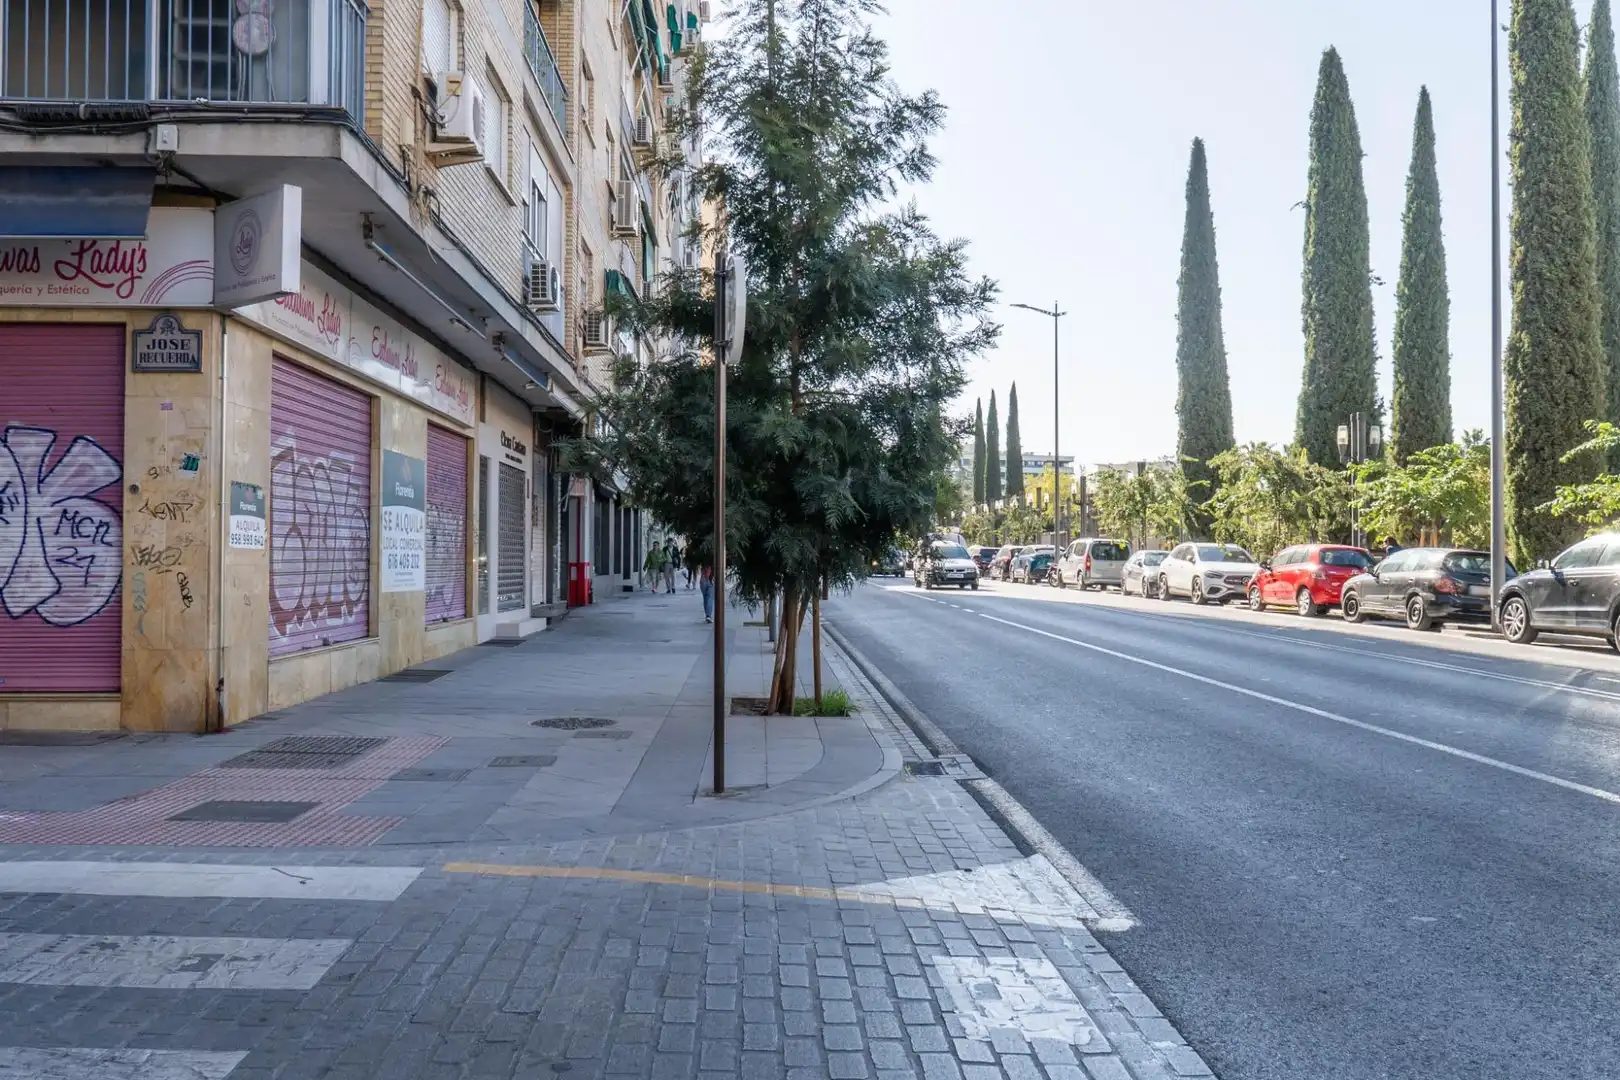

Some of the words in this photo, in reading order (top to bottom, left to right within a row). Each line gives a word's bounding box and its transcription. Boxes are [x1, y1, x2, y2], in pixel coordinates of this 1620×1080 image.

[0, 247, 40, 273] vas
[54, 240, 147, 299] Lady's
[37, 287, 43, 296] y
[47, 284, 90, 295] Estética
[146, 338, 191, 351] JOSE
[139, 351, 197, 365] RECUERDA
[236, 519, 260, 533] ALQUILA
[383, 510, 393, 531] SE
[395, 511, 424, 535] ALQUILA
